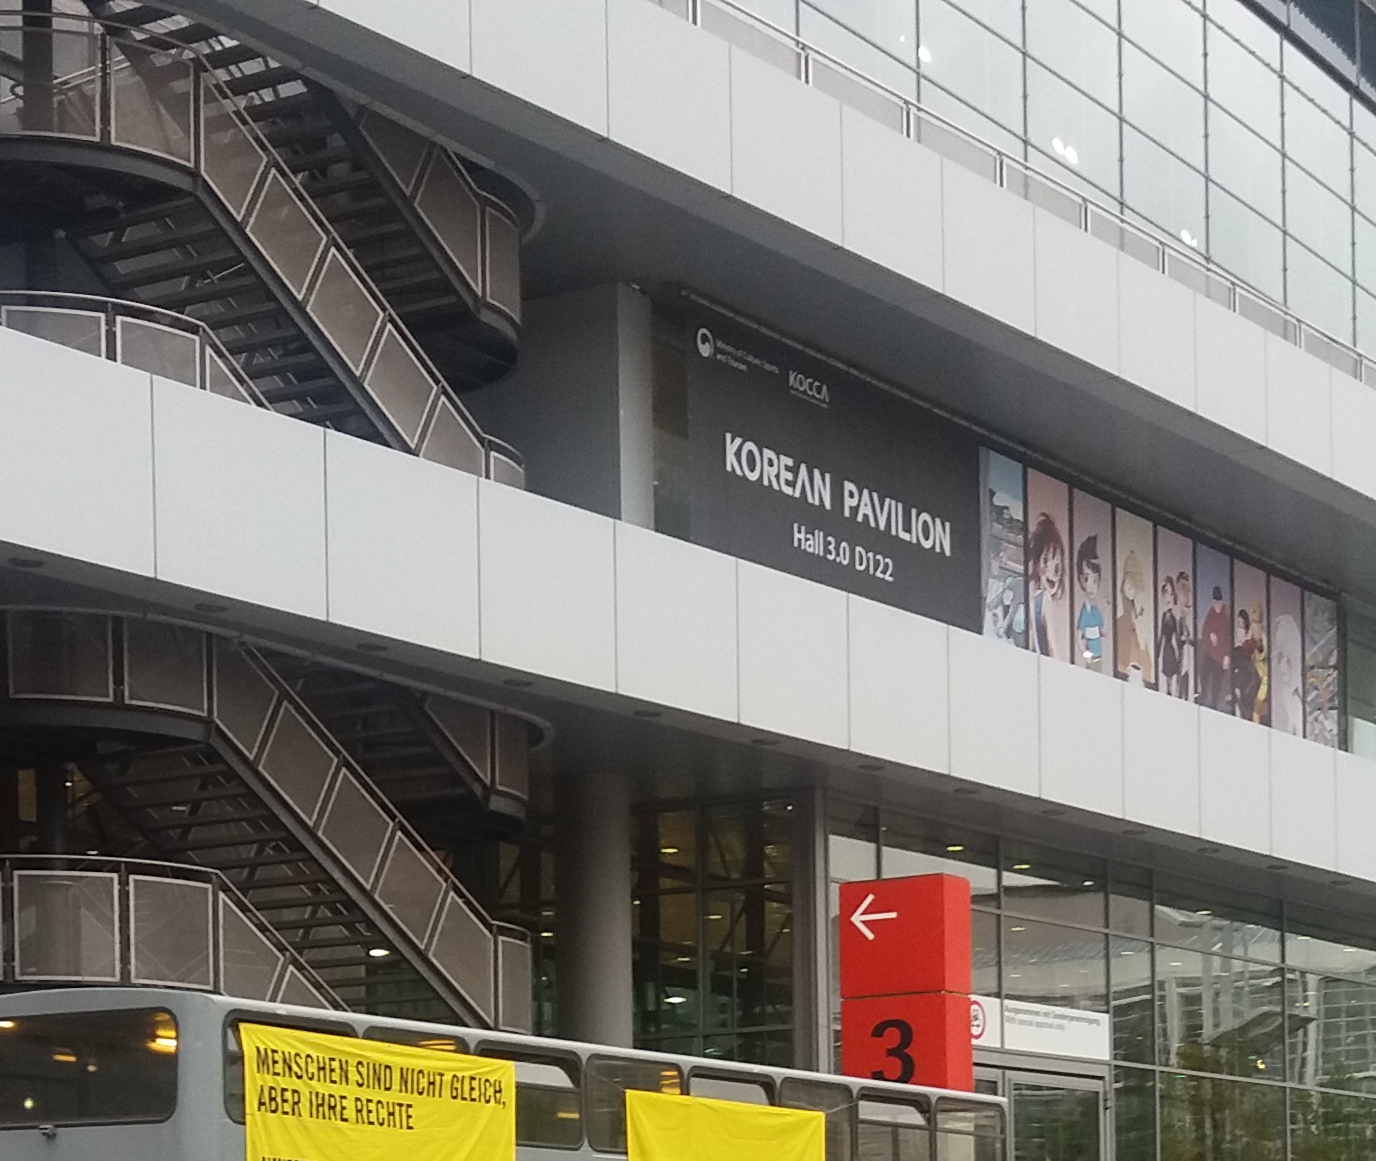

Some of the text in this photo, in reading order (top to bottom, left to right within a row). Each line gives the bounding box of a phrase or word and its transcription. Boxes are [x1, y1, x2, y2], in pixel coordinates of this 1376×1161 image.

[789, 370, 829, 402] KOCCA
[725, 432, 951, 557] KOREAN PAVILION
[793, 522, 894, 582] Hall 3.0 D122
[255, 1046, 506, 1109] MENSCHEN SIND NICHT GLEICH,
[870, 1018, 915, 1084] 3
[257, 1084, 414, 1131] ABER IHRE RECHTE
